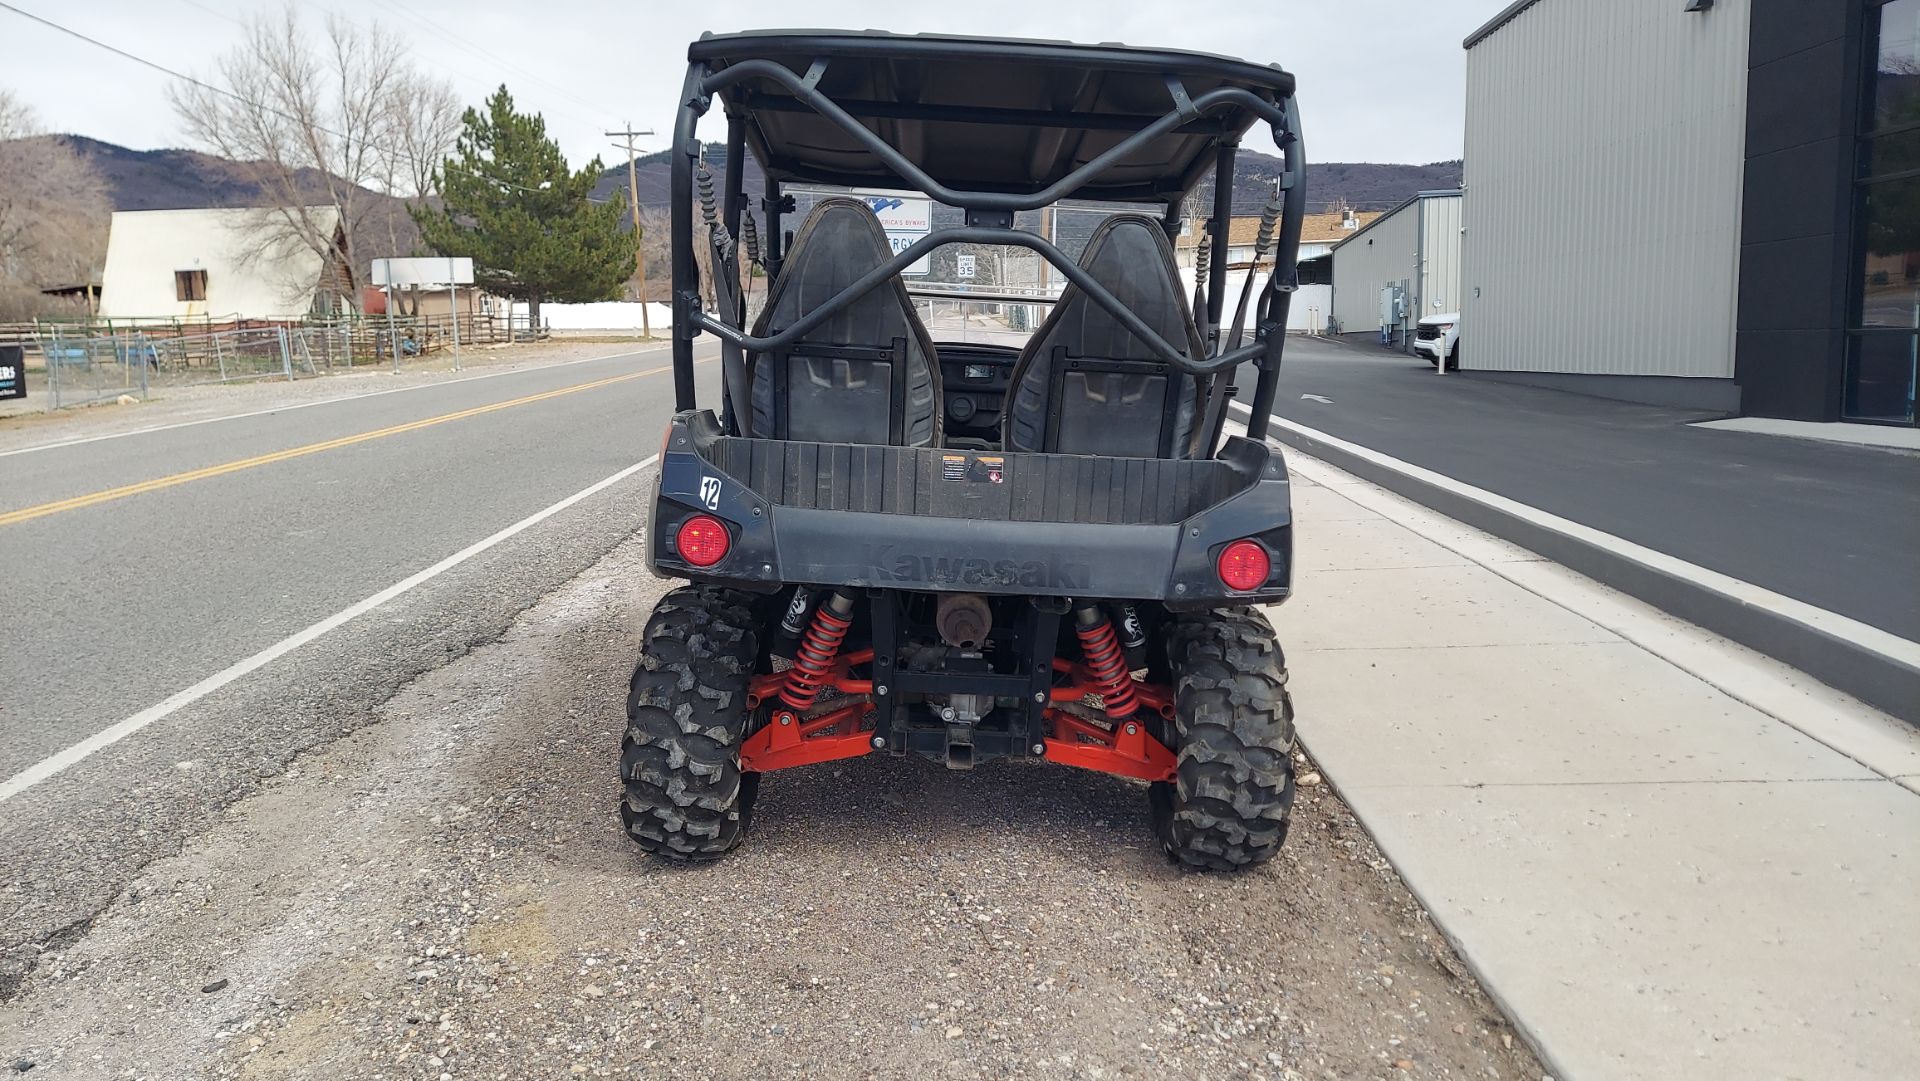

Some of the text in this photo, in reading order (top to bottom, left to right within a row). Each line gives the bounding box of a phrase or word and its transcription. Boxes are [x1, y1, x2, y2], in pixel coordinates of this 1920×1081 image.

[887, 238, 914, 250] RGY
[959, 266, 974, 276] 35
[704, 479, 720, 508] 12
[861, 544, 1092, 590] Kawasaki
